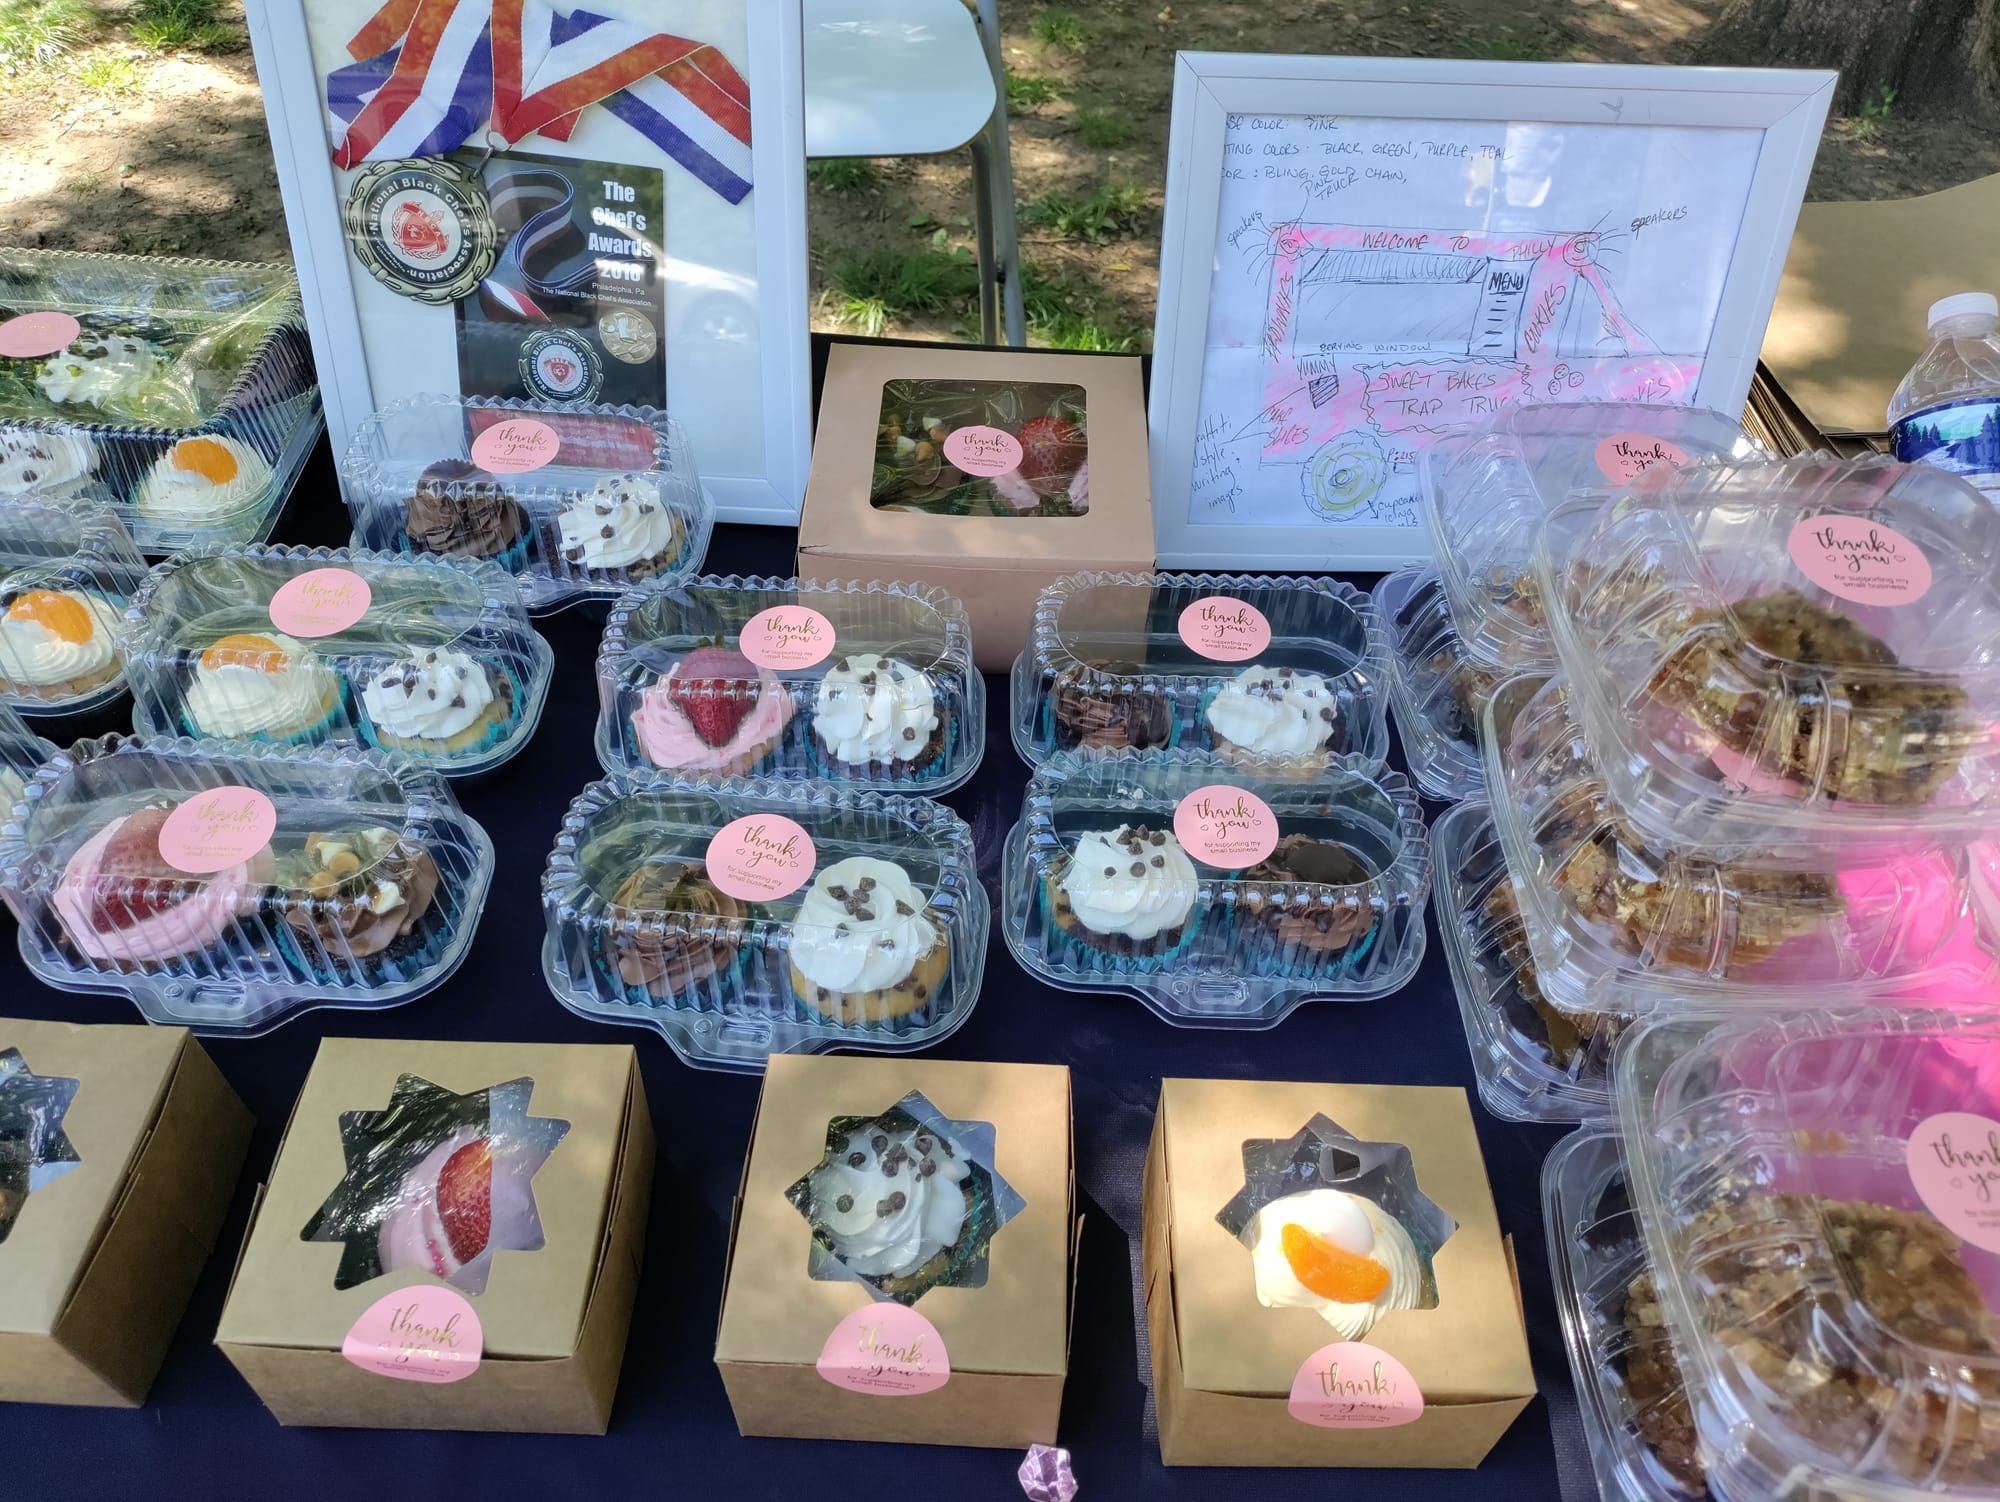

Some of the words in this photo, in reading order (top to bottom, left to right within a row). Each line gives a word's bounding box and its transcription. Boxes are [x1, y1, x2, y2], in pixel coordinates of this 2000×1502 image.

[1304, 117, 1339, 131] PINK
[1480, 144, 1514, 160] TEAL
[1319, 165, 1356, 177] GOLD
[402, 178, 441, 195] Black
[602, 180, 635, 202] The
[368, 182, 400, 230] National
[445, 193, 471, 236] Chef's
[591, 206, 647, 231] Chef's
[588, 232, 653, 258] Awards
[1362, 232, 1429, 250] WELCOME
[1449, 235, 1470, 252] TO
[1505, 234, 1557, 259] PHILLY
[410, 240, 472, 282] Association
[1488, 271, 1524, 291] MENU
[542, 286, 554, 294] The
[555, 288, 580, 297] National
[580, 291, 597, 299] Black
[1373, 371, 1436, 392] SWEET
[1437, 370, 1497, 391] BAKES
[1384, 398, 1443, 416] TRAP
[499, 427, 547, 444] thank
[961, 433, 1008, 447] thank
[504, 444, 537, 455] you
[975, 446, 1001, 456] you
[1611, 441, 1672, 460] thank
[1634, 459, 1654, 472] yo
[1810, 527, 1895, 553] thank
[1844, 554, 1890, 573] you
[765, 615, 820, 635] thank
[1200, 605, 1254, 626] thank
[1214, 624, 1246, 637] you
[776, 634, 810, 648] you
[197, 798, 259, 821] thank
[1192, 796, 1255, 819] thank
[1215, 820, 1249, 839] you
[743, 825, 801, 859] thank
[746, 850, 787, 868] you
[1968, 1171, 2000, 1203] yo
[390, 1303, 461, 1348] thank
[867, 1363, 914, 1377] you
[1315, 1361, 1396, 1397] thank
